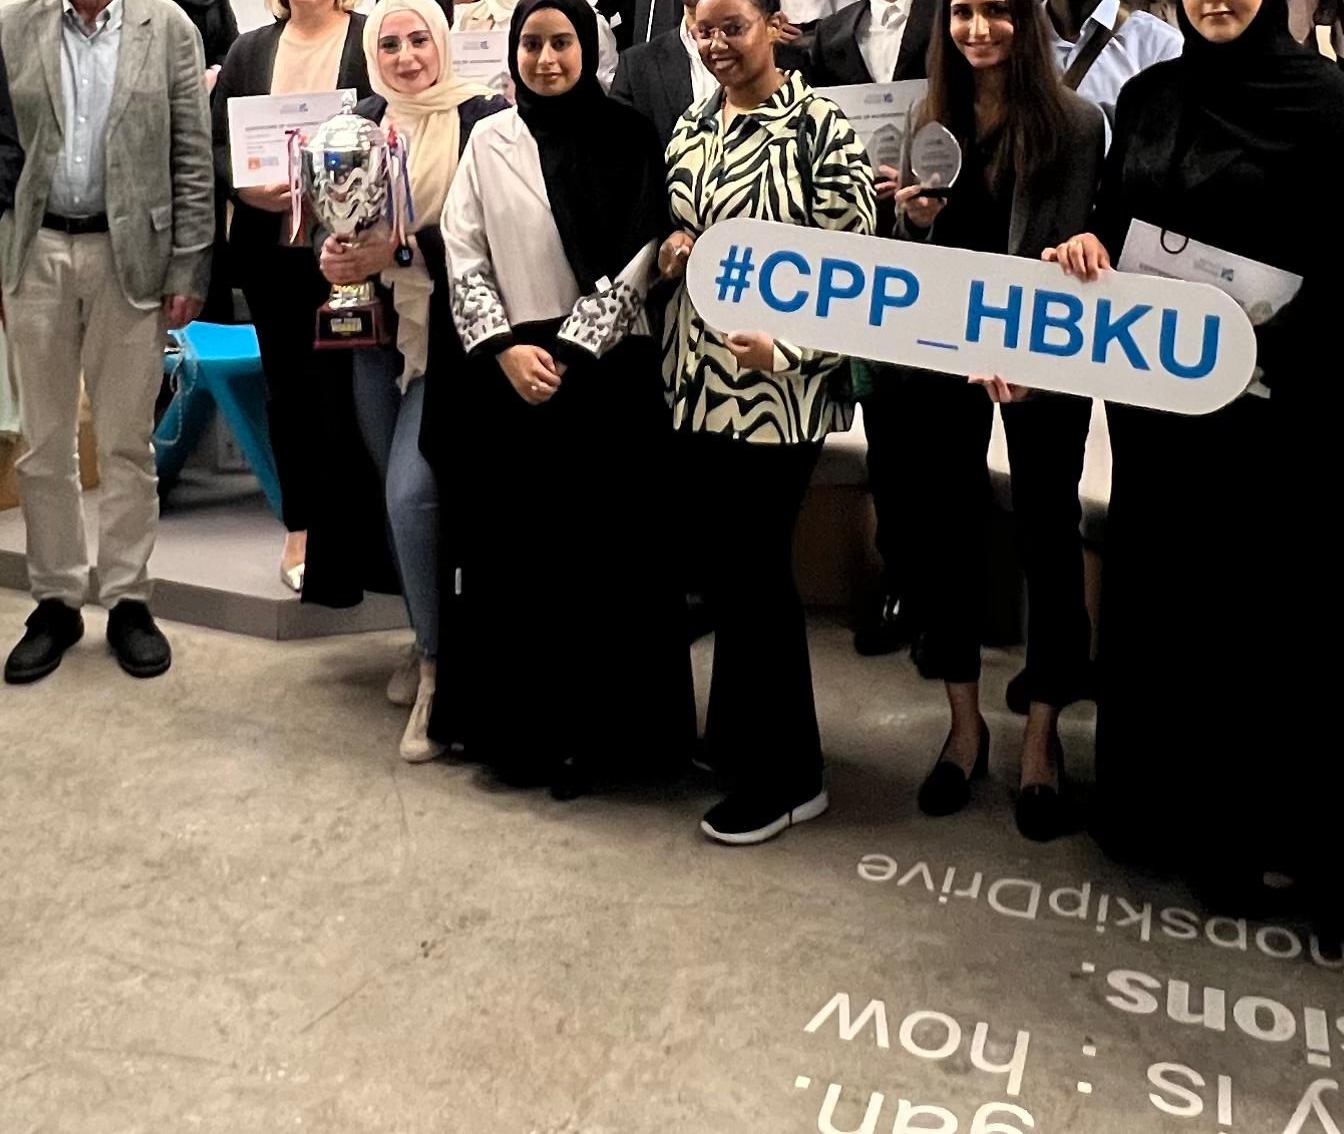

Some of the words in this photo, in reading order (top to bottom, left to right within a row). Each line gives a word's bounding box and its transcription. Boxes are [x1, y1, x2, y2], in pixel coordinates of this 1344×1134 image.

[714, 244, 1221, 379] #CPP_HBKU
[803, 992, 1030, 1096] how
[1147, 1062, 1233, 1134] is
